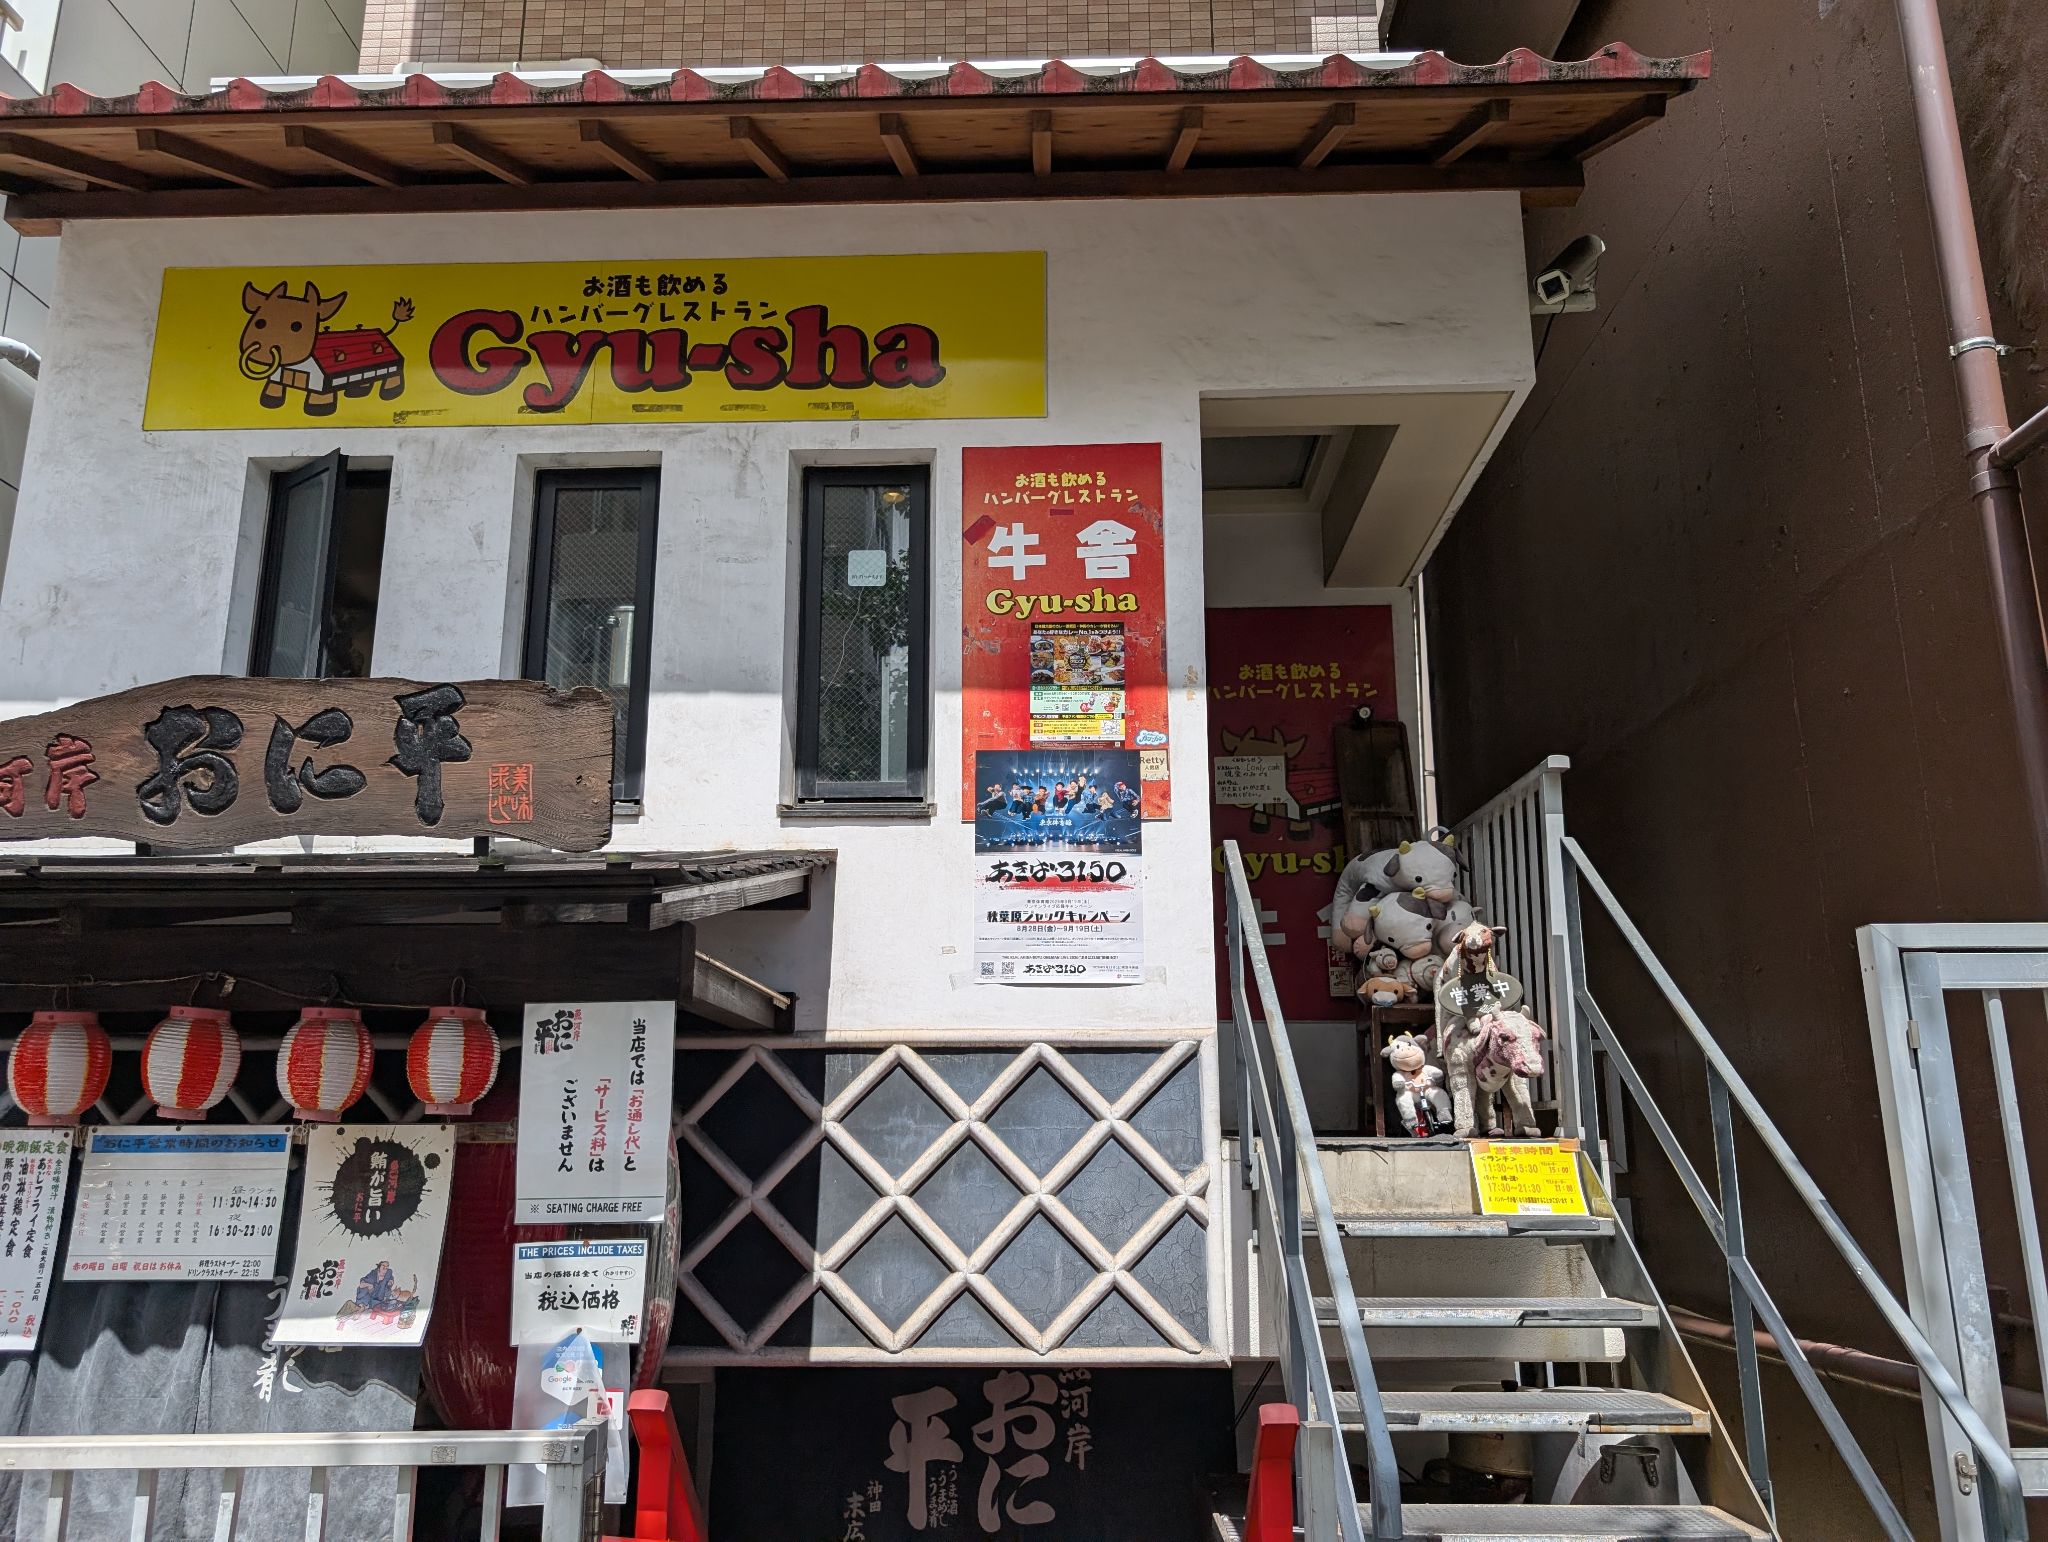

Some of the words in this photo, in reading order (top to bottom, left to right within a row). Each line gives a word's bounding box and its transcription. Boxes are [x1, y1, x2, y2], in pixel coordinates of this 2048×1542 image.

[583, 273, 728, 297] お酒も飲める
[530, 301, 778, 324] ハンバーグレストラン
[429, 304, 947, 413] Gyu-sha
[1014, 471, 1107, 488] お酒も飲める
[983, 489, 1139, 504] ハンバーグレストラン
[987, 520, 1137, 580] 牛舎
[985, 588, 1139, 619] Gyu-sha
[1239, 662, 1342, 680] お酒も飲める
[1208, 683, 1378, 700] ハンバーグレストラン
[1140, 756, 1165, 765] Retty
[986, 910, 1131, 923] 秋葉原ジャックキャンペーン
[1449, 979, 1510, 1006] 営業中
[557, 1078, 578, 1173] ございません
[1493, 1145, 1553, 1156] 営業時間
[249, 1187, 276, 1195] ランチ
[365, 1151, 388, 1224] 鮪が旨い
[23, 1157, 46, 1258] あじフライ定食
[212, 1196, 277, 1209] 11:30~14:30
[546, 1203, 584, 1214] SEATING
[586, 1202, 619, 1213] CHARGE
[622, 1201, 643, 1213] FREE
[209, 1224, 273, 1237] 16:30~23:00
[521, 1247, 539, 1258] THE
[543, 1246, 575, 1256] PRICES
[578, 1246, 614, 1256] INCLUDE
[617, 1245, 643, 1255] TAXES
[72, 1262, 105, 1271] 赤の曜日
[111, 1262, 128, 1271] 日曜
[159, 1262, 182, 1271] お休み
[199, 1259, 240, 1268] 料理ラストオーダー
[242, 1259, 261, 1268] 22:00
[187, 1268, 239, 1277] ドリンクラストオーダー
[241, 1268, 260, 1277] 22:15
[524, 1269, 599, 1280] 当店の価格は全て
[537, 1289, 621, 1311] 税込価格
[548, 1375, 573, 1384] Google
[867, 1480, 883, 1513] 神田
